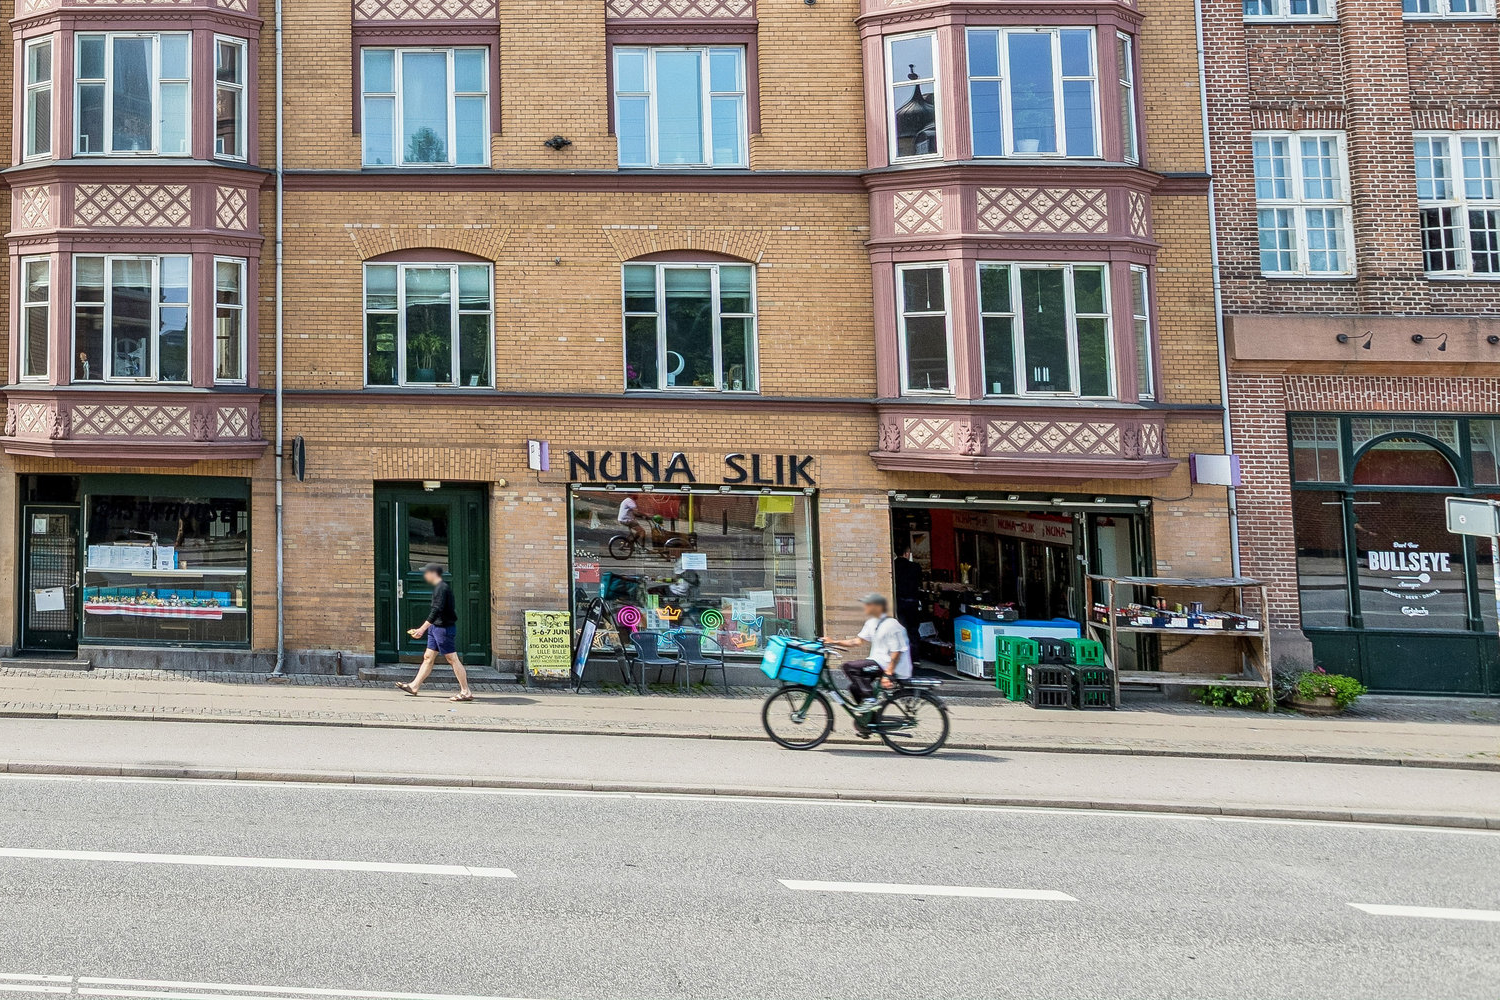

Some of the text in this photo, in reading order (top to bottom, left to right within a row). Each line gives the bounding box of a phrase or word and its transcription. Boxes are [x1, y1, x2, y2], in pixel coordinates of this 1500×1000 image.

[567, 450, 816, 485] NUNA SLIK
[1368, 551, 1451, 572] BULLSEYE
[1401, 606, 1429, 617] Carlsberg
